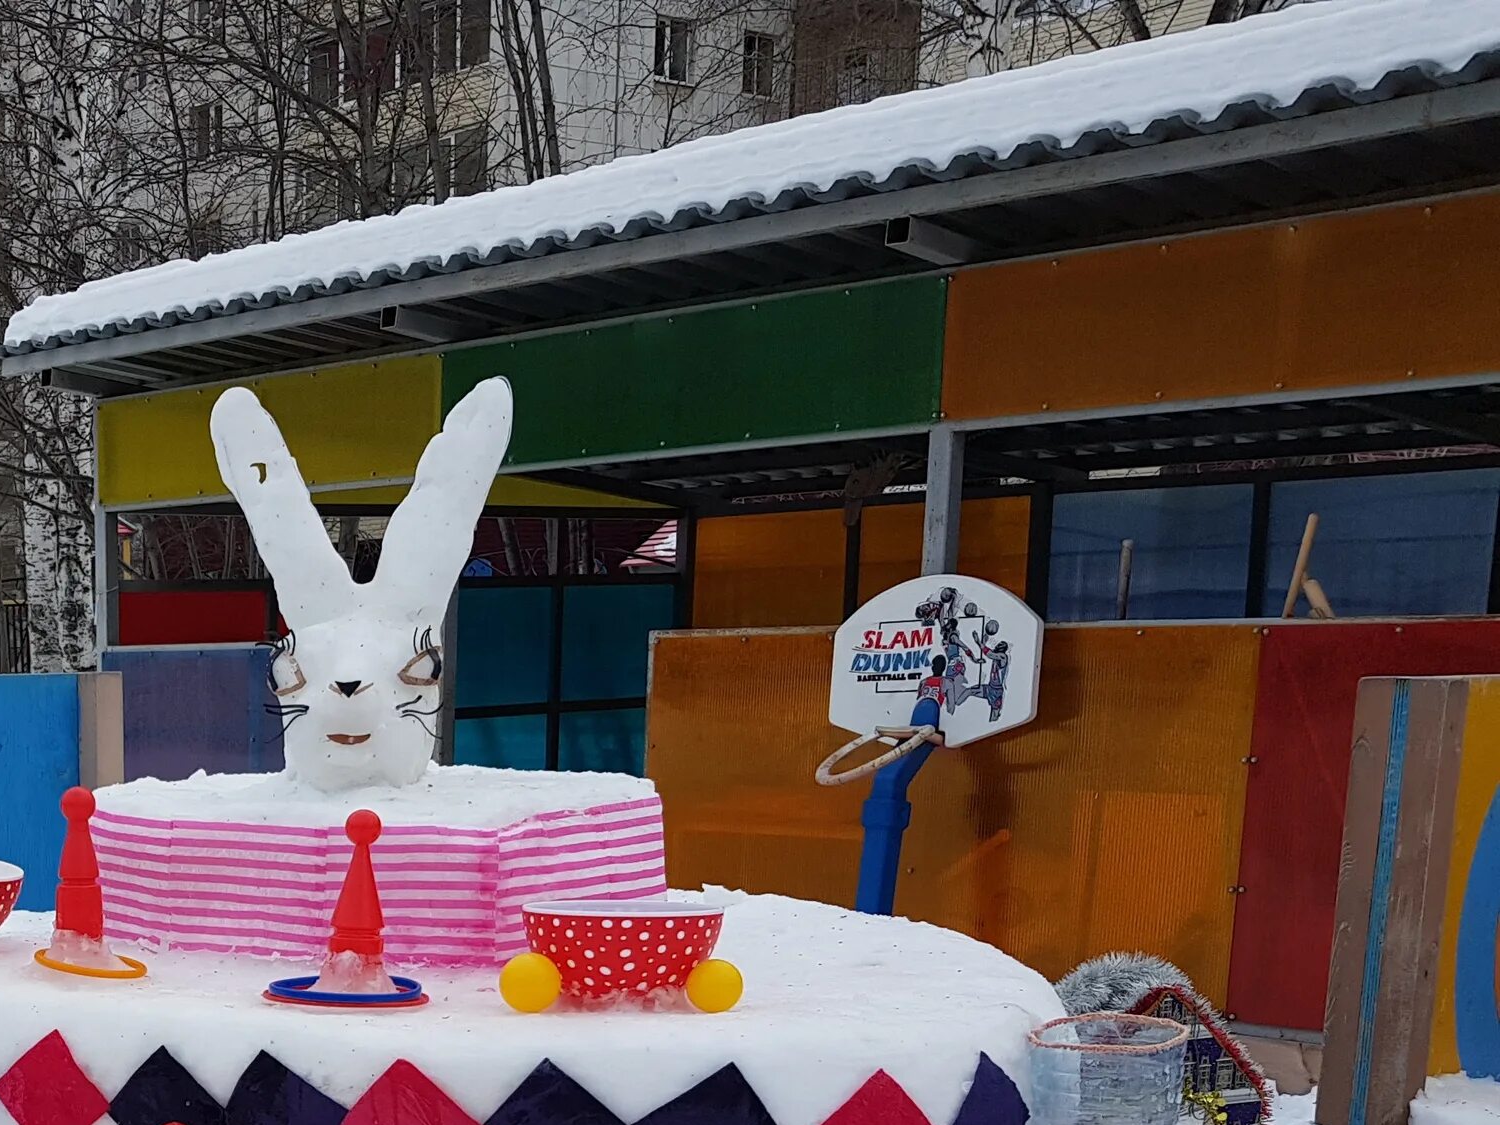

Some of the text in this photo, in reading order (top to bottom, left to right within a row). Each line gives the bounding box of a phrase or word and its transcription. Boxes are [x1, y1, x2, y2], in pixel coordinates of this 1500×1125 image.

[861, 628, 933, 650] SLAM
[850, 648, 933, 673] DUNK
[857, 673, 906, 682] BASKETBALL
